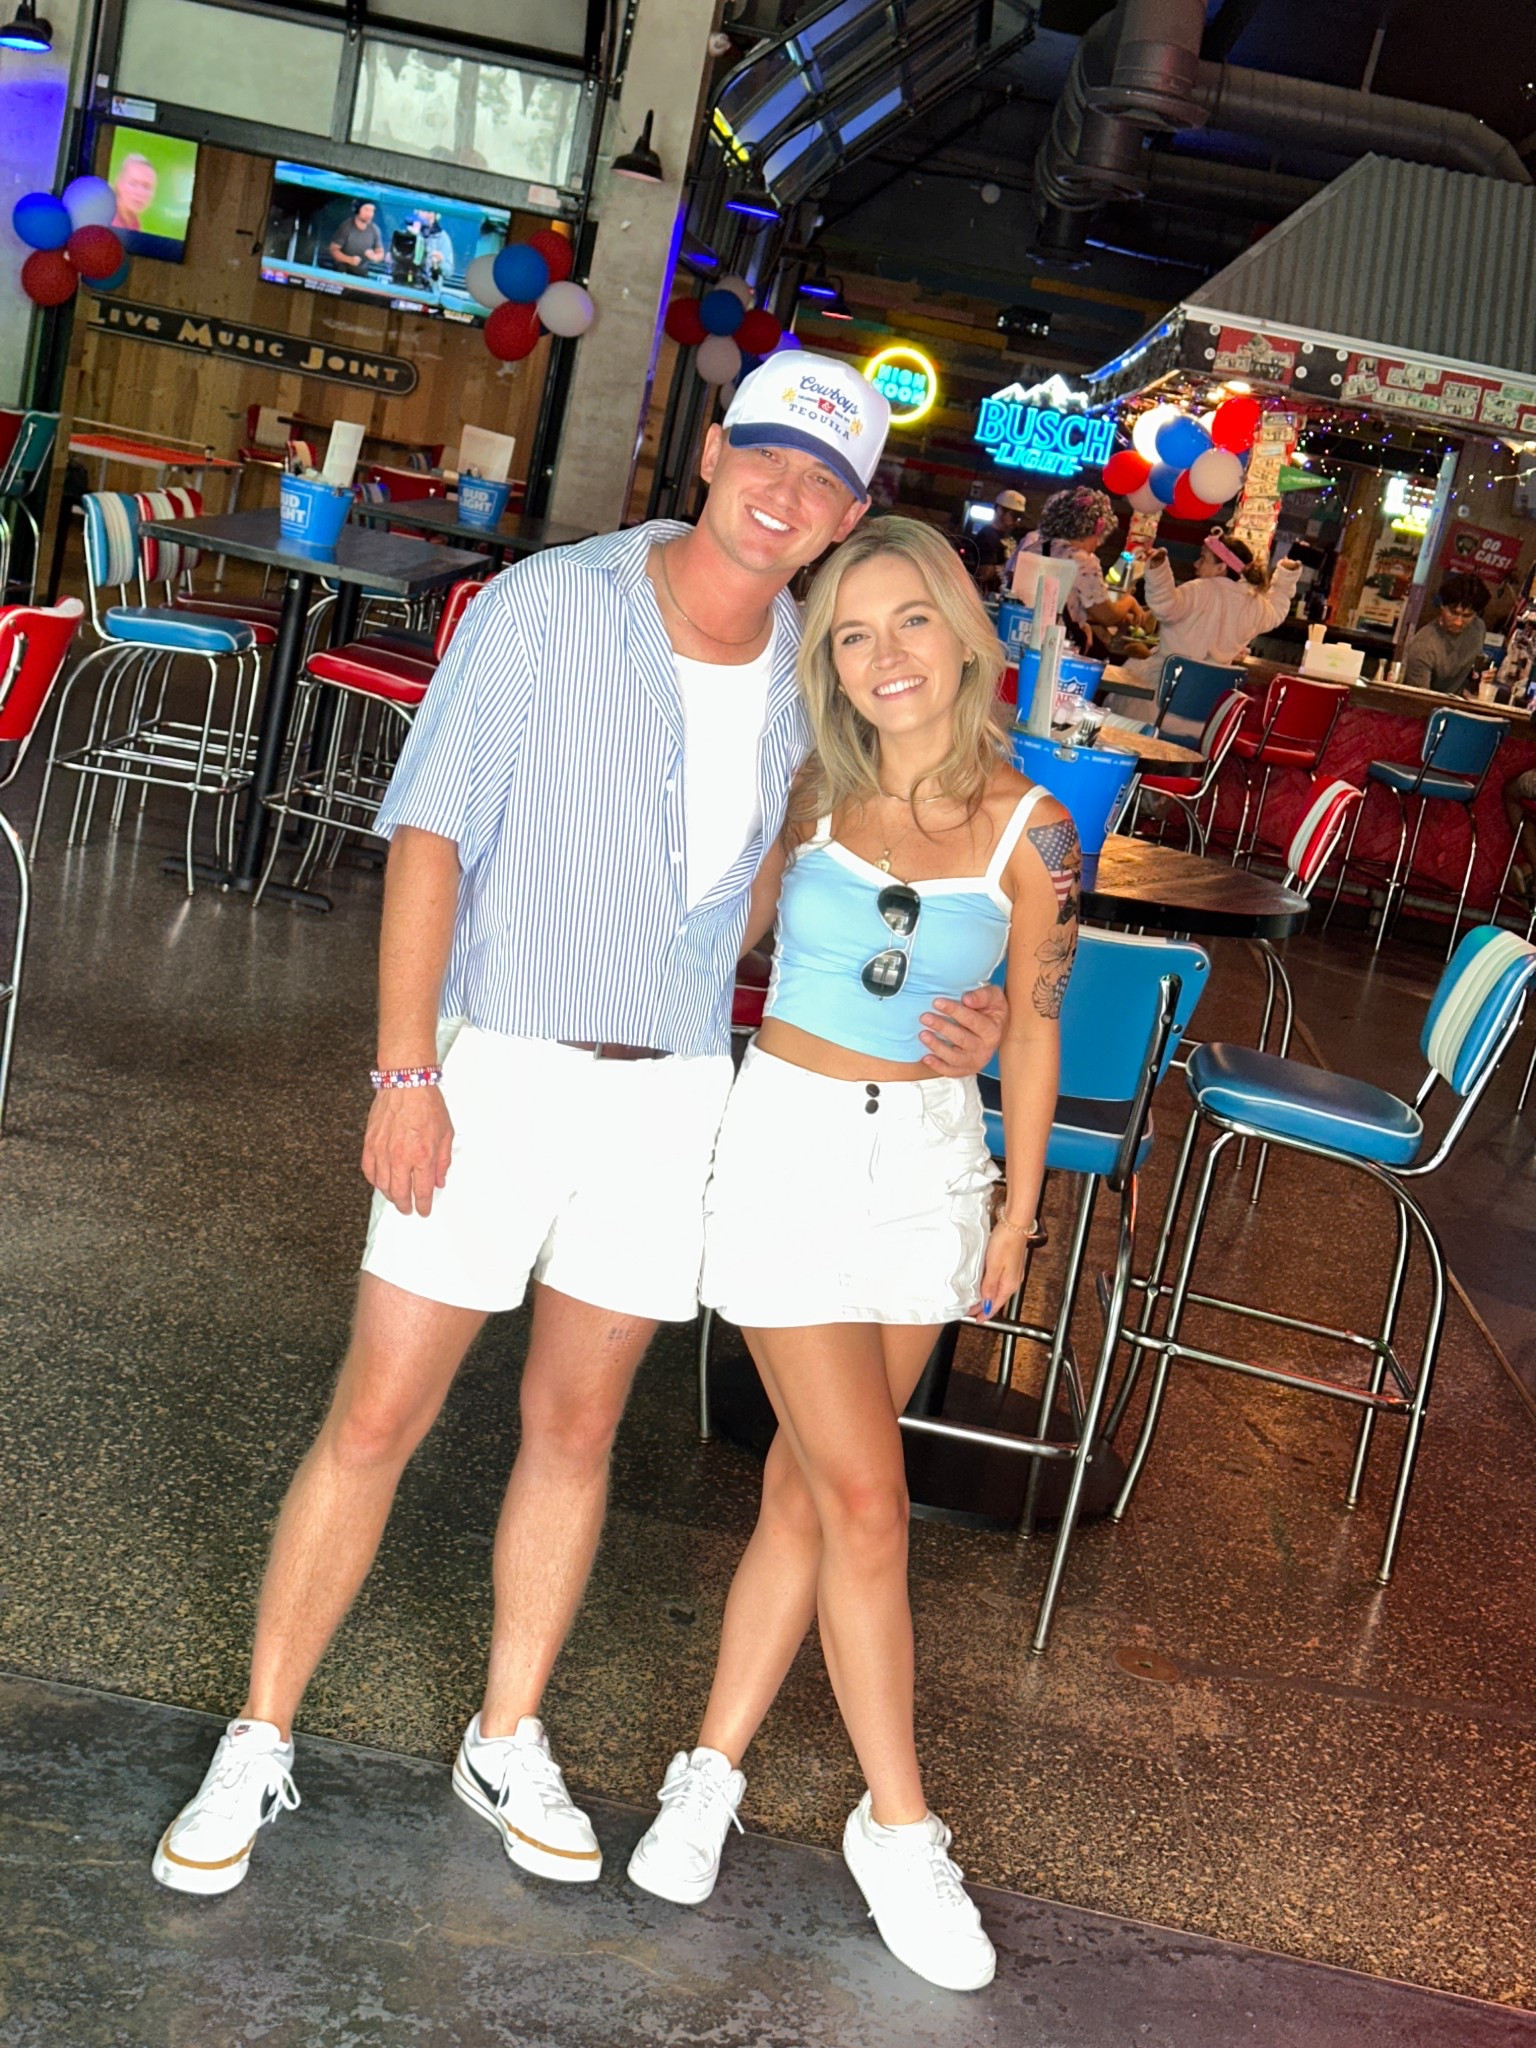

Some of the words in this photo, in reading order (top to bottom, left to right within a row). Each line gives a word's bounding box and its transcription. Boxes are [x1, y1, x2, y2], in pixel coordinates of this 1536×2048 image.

[800, 376, 859, 415] Cowboys
[788, 403, 850, 440] TEQUILA
[974, 398, 1117, 465] BUSCH
[994, 442, 1078, 475] LIGHT
[281, 492, 301, 508] UD
[1475, 550, 1512, 570] CATS!
[1482, 538, 1502, 552] GO
